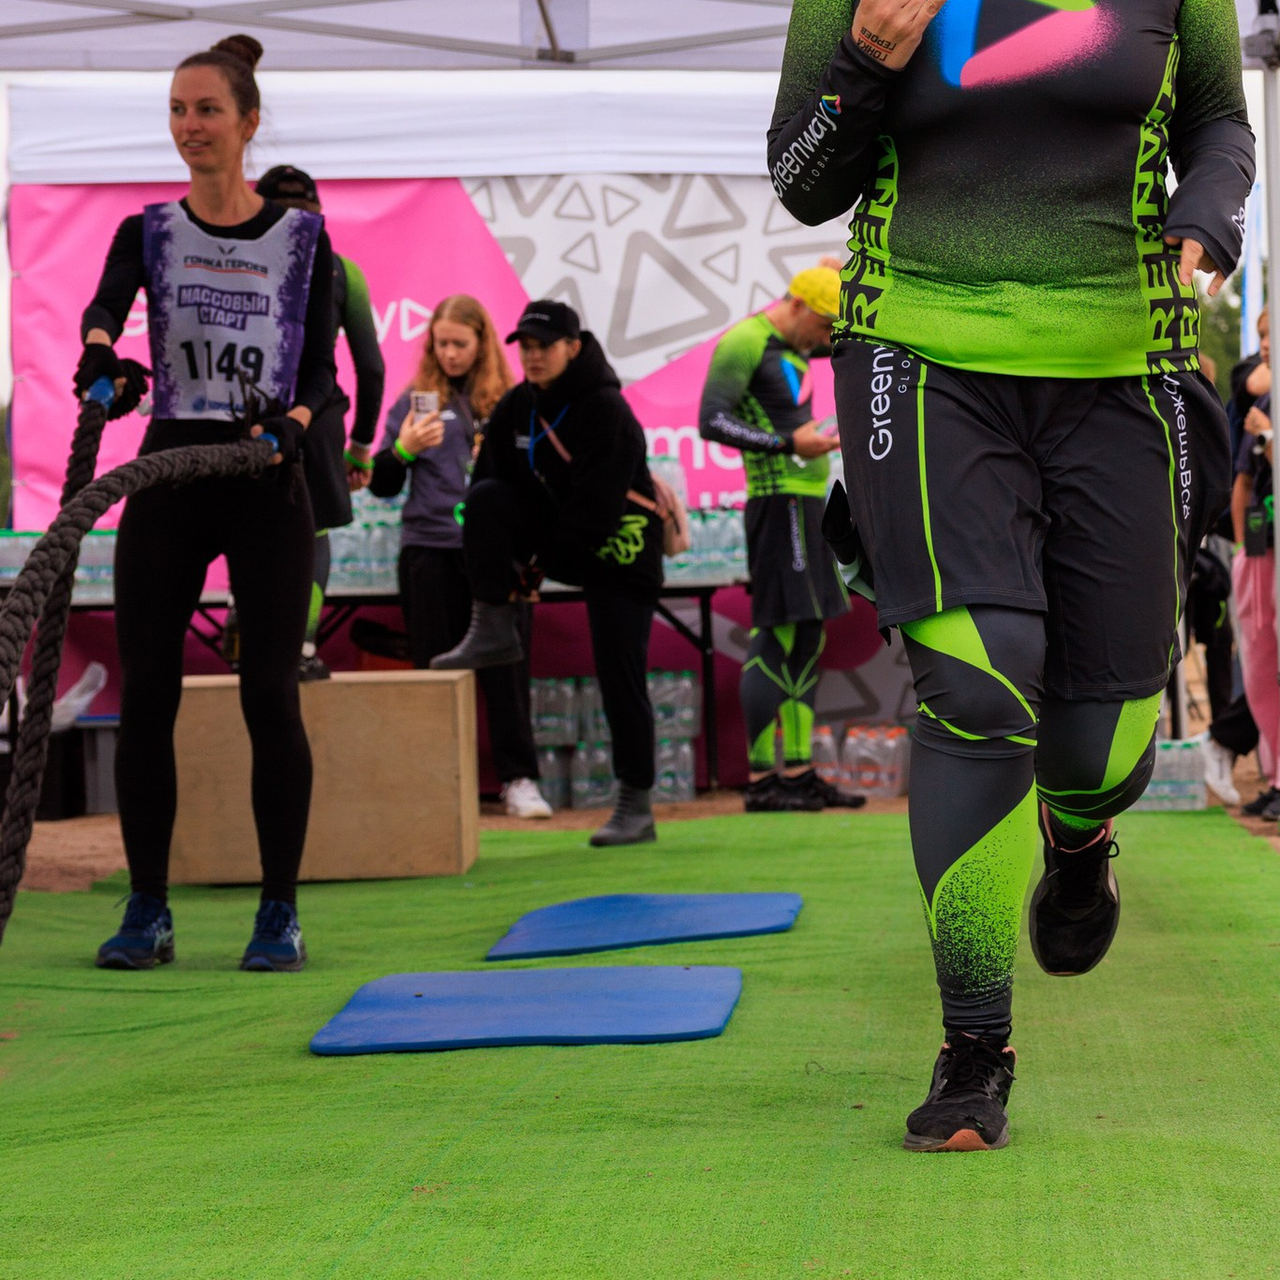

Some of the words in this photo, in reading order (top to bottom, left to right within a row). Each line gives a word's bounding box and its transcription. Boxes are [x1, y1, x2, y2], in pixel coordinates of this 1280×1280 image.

[856, 37, 888, 62] ГОНКА
[860, 26, 897, 51] ГЕРОЕВ
[801, 146, 836, 192] GLOBAL
[180, 286, 269, 314] МАССОВЫЙ
[199, 306, 246, 329] СТАРТ
[180, 339, 265, 384] 1149
